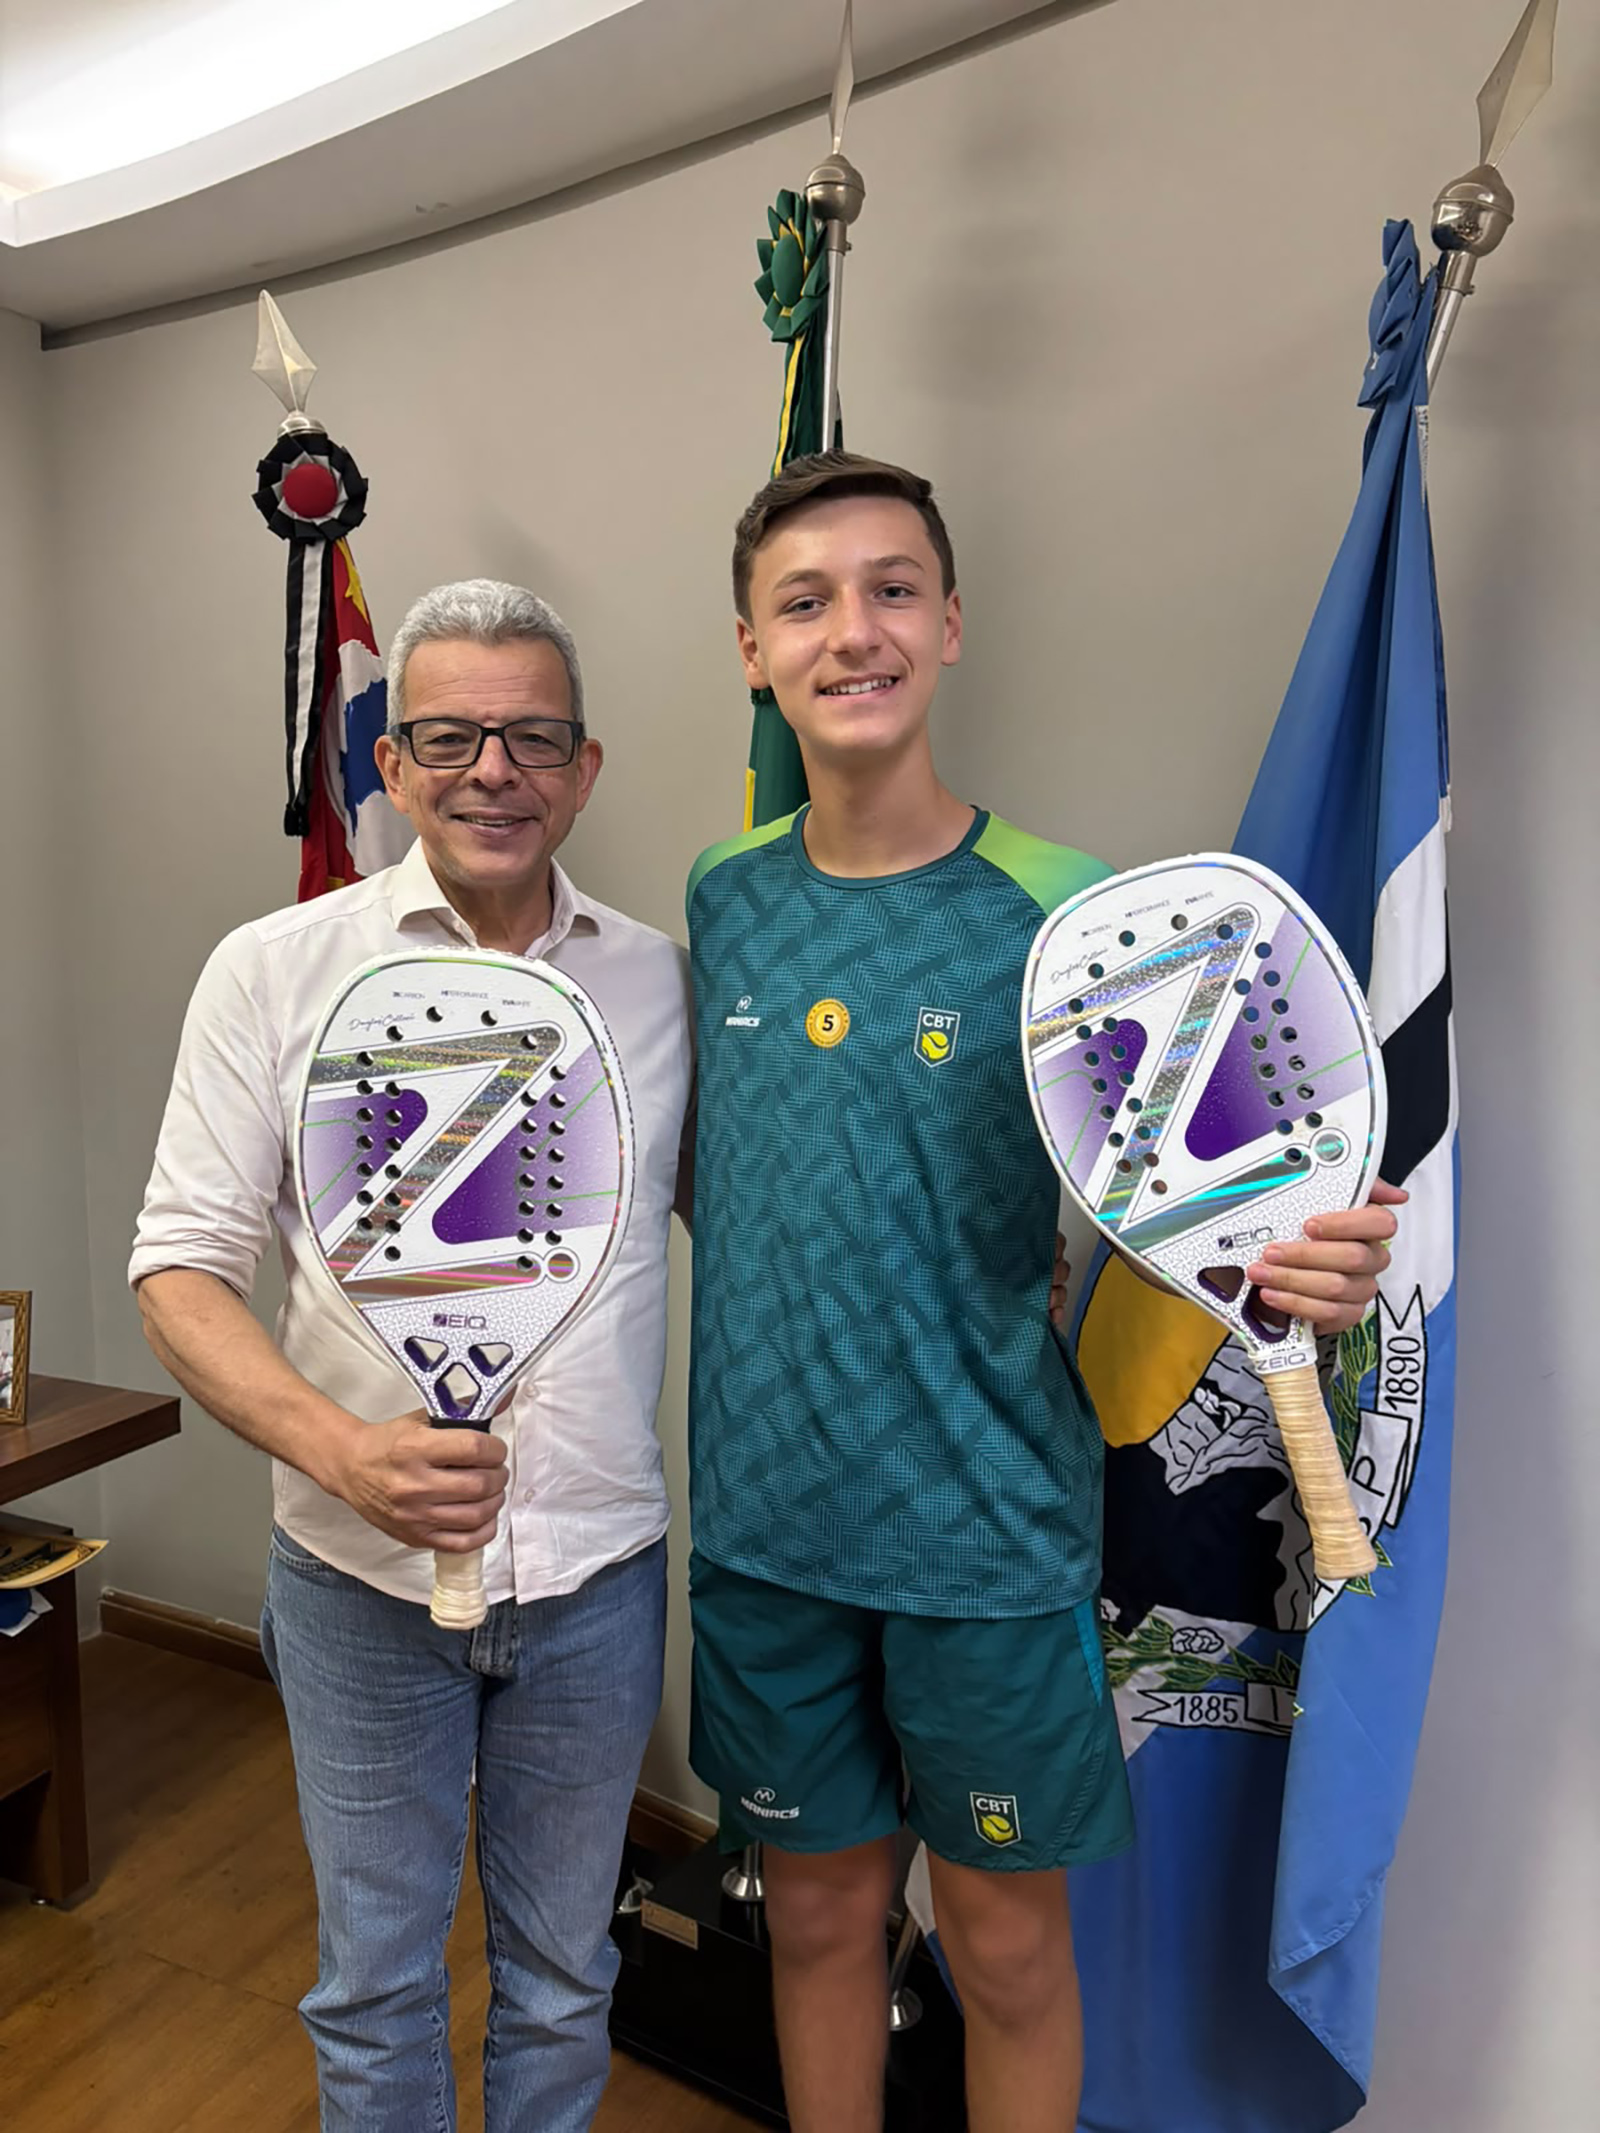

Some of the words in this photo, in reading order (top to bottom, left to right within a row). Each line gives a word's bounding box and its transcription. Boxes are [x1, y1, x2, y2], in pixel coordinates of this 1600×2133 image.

[822, 1014, 834, 1032] 5
[922, 1013, 955, 1030] CBT
[1257, 1352, 1307, 1371] ZEIQ
[1384, 1336, 1421, 1411] 1890
[1173, 1695, 1238, 1723] 1885
[976, 1797, 1011, 1814] CBT
